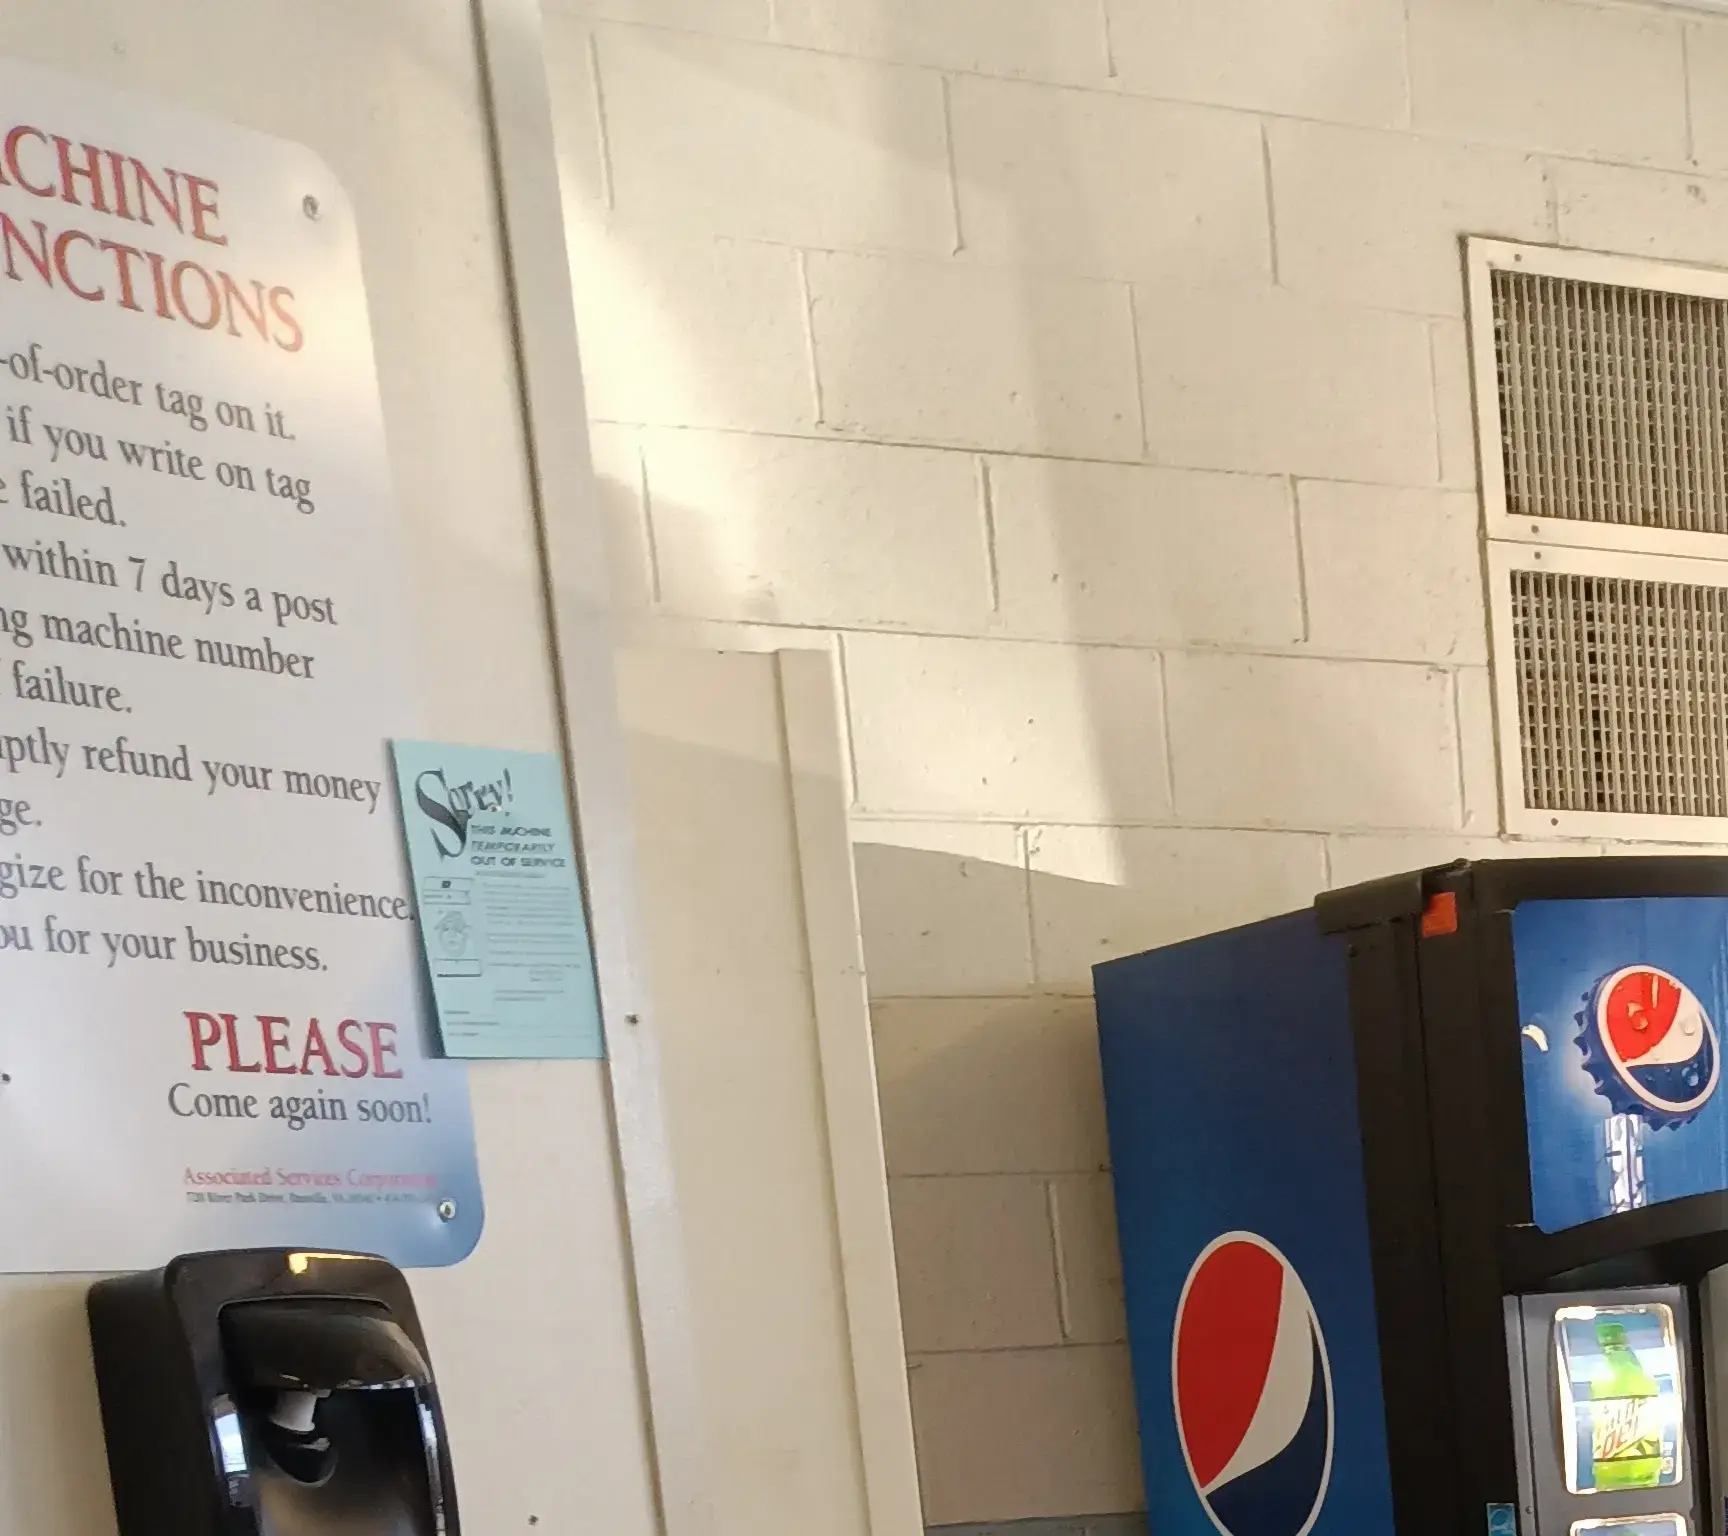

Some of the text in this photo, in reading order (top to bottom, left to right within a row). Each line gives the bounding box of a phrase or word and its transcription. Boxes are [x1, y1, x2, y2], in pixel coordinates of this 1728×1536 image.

[0, 125, 228, 247] CHINE
[0, 211, 304, 353] NCTIONS
[155, 381, 208, 432] tag
[216, 399, 256, 432] on
[264, 402, 296, 441] it.
[7, 404, 316, 515] if you write on tag
[20, 469, 127, 528] failed.
[2, 540, 338, 628] within 7 days a post
[41, 612, 186, 660] machine
[194, 636, 315, 680] number
[13, 659, 133, 714] failure.
[0, 726, 381, 815] ptly refund your money
[77, 855, 124, 896] for
[135, 861, 186, 902] the
[196, 869, 416, 921] inconvenience.
[44, 914, 92, 956] for
[101, 930, 177, 969] your
[185, 924, 329, 973] business.
[183, 1010, 404, 1080] PLEASE
[168, 1081, 433, 1132] Come again soon!
